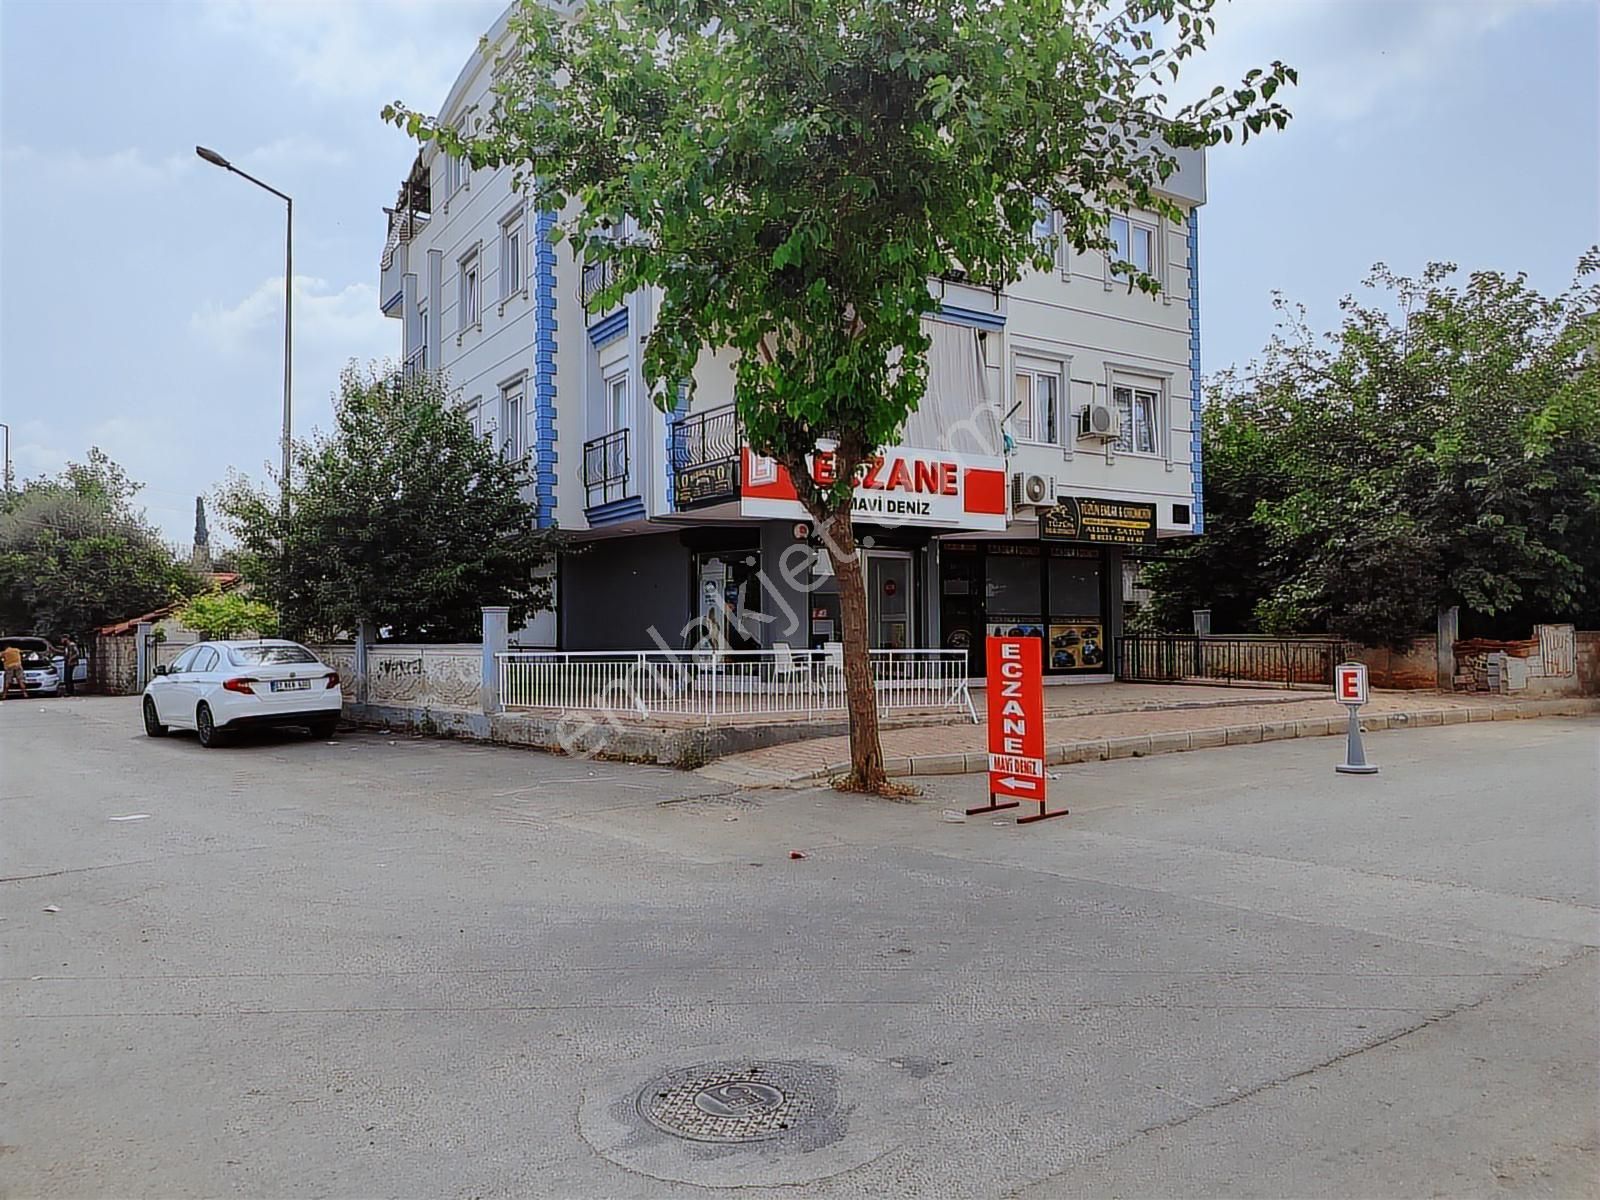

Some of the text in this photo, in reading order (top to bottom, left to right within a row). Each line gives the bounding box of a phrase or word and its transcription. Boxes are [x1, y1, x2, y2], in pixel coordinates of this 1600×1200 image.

[887, 499, 930, 515] DENİZ
[1343, 672, 1358, 697] E
[1001, 643, 1026, 754] ECZANE
